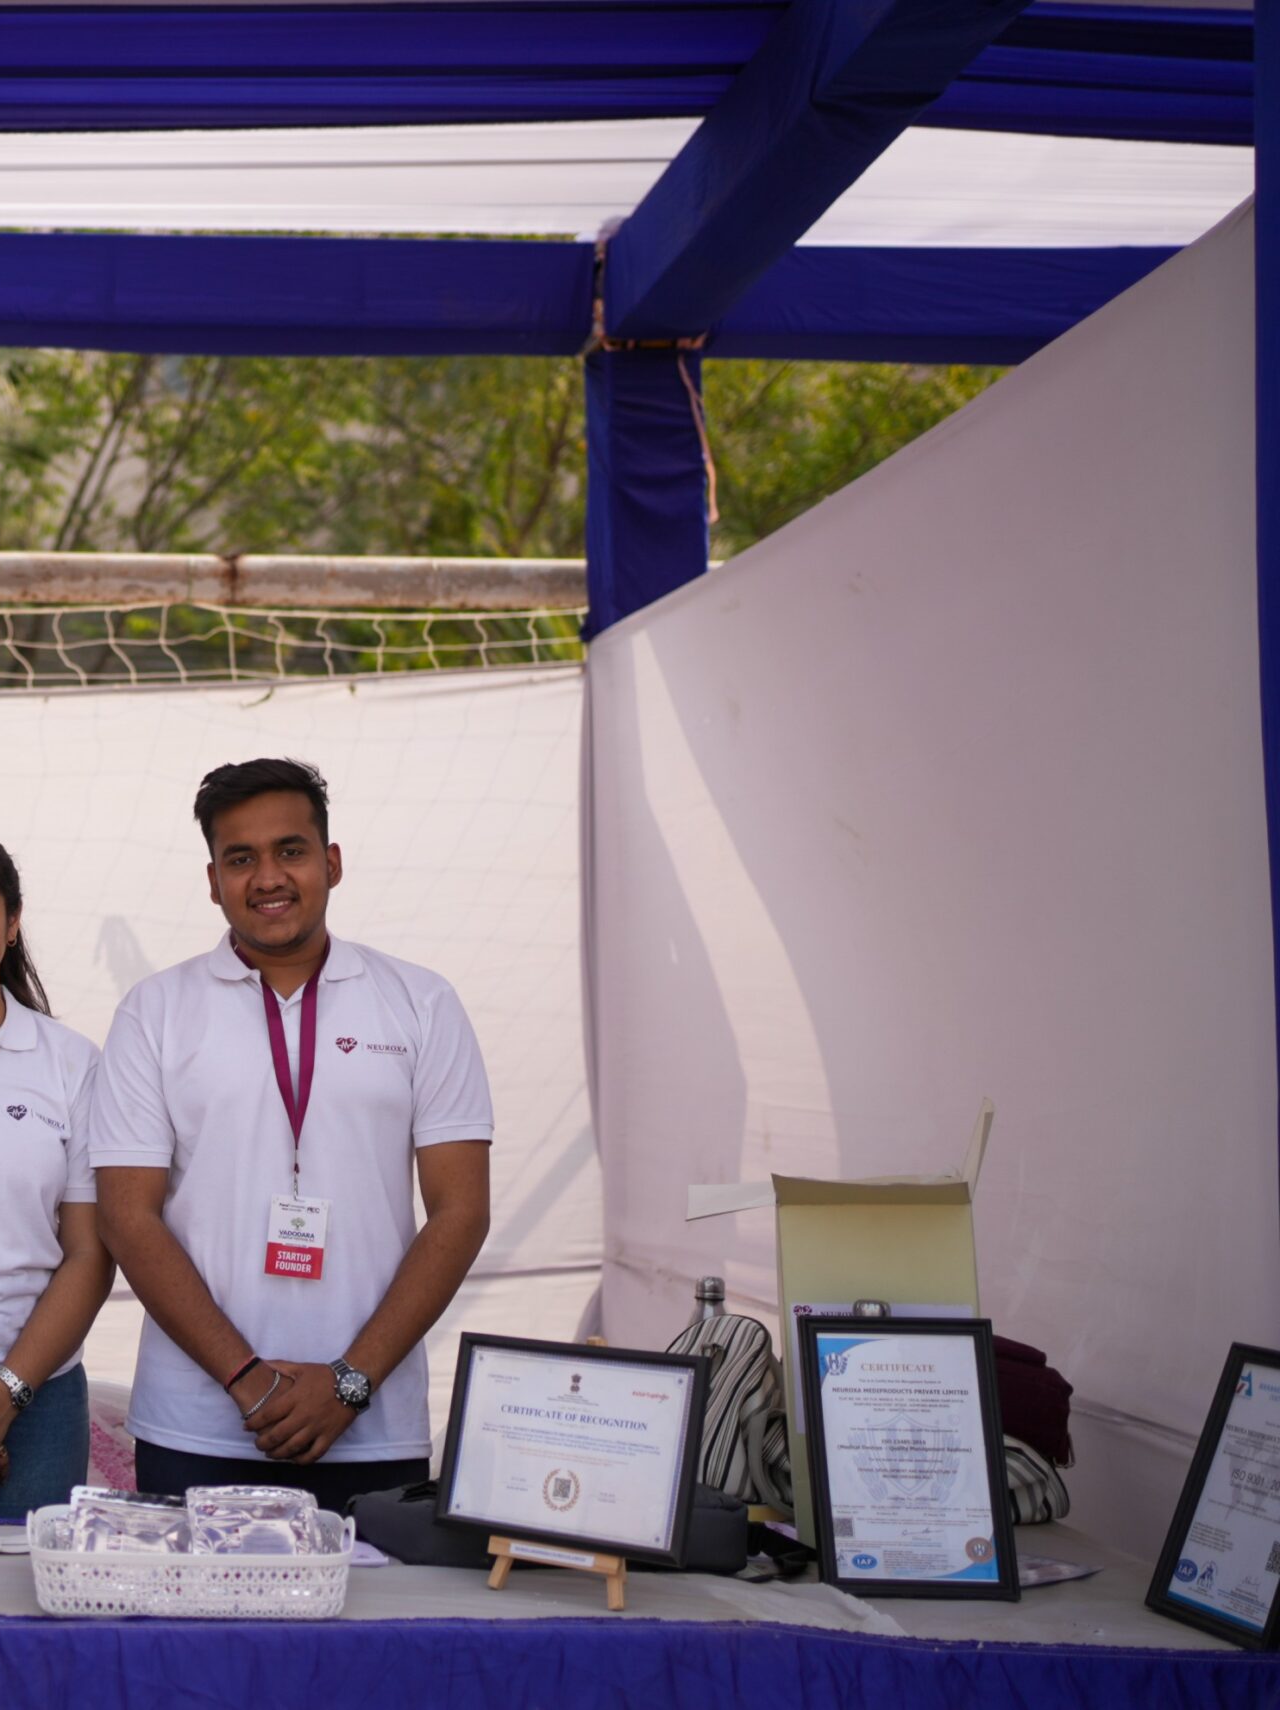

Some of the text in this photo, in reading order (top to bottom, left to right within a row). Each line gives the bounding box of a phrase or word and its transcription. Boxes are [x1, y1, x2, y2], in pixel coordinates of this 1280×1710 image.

[366, 1043, 408, 1054] NEUROXA
[279, 1230, 315, 1239] VADODARA
[277, 1251, 312, 1263] STARTUP
[275, 1260, 312, 1273] FOUNDER
[861, 1362, 936, 1373] CERTIFICATE
[863, 1387, 912, 1395] MEDIPRODUCTS
[913, 1388, 940, 1396] PRIVATE
[500, 1404, 648, 1431] CERTIFICATE OF RECOGNITION
[856, 1558, 873, 1566] IAF
